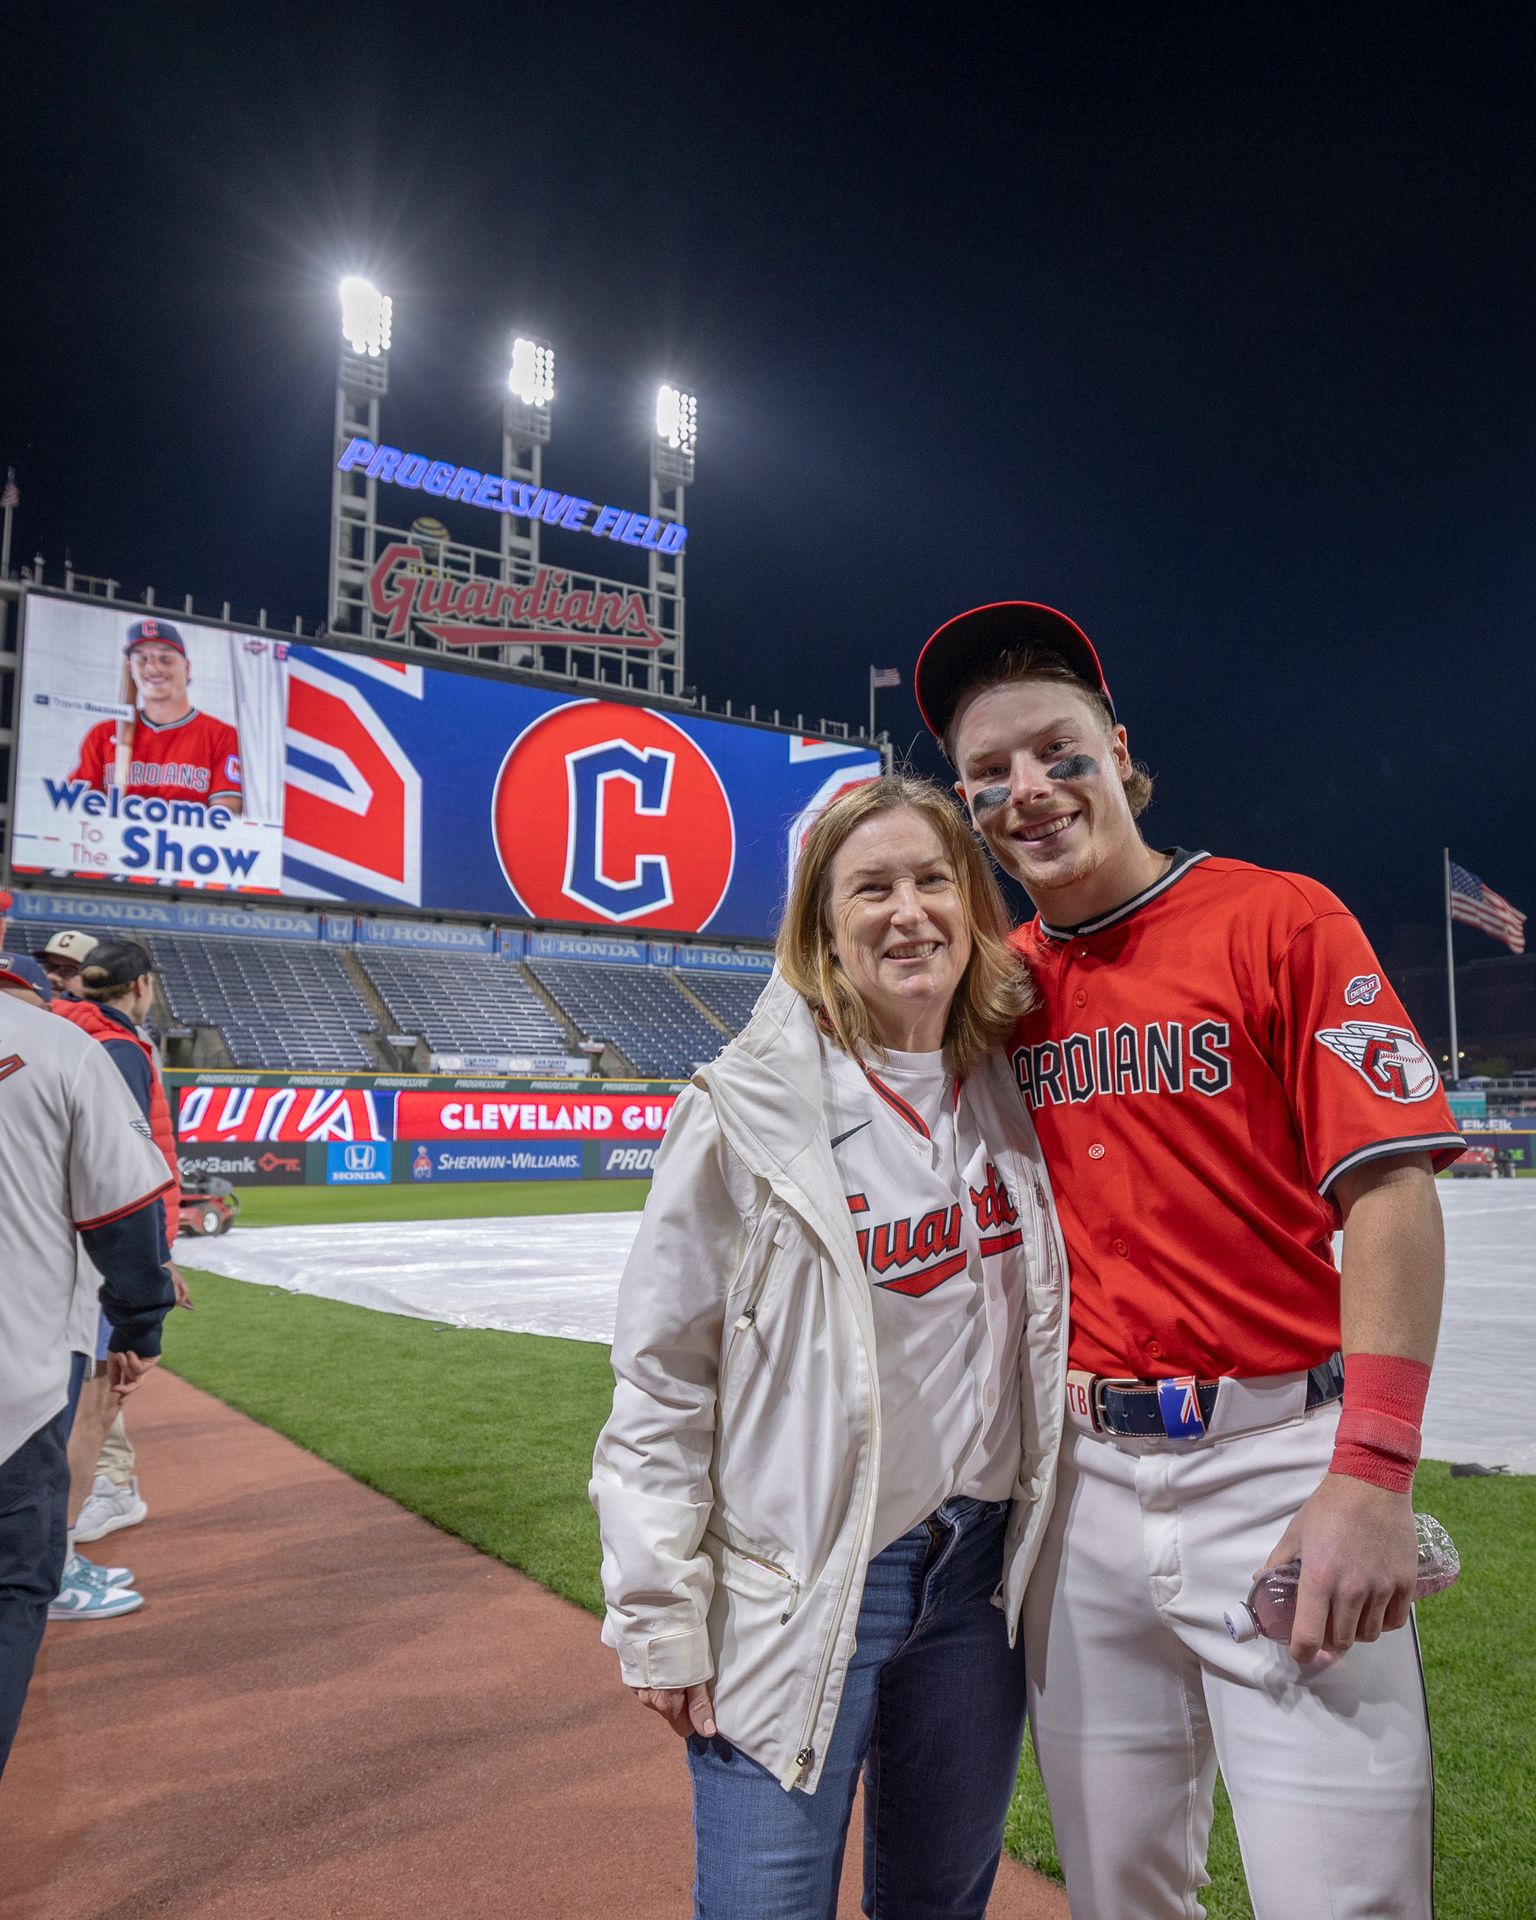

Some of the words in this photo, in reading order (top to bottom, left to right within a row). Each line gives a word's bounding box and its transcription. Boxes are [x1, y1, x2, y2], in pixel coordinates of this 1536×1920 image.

[337, 437, 592, 532] PROGRESSIVE
[592, 505, 689, 555] FIELD
[368, 542, 664, 648] Guardians
[42, 778, 232, 831] Welcome
[79, 822, 103, 843] To
[562, 738, 676, 922] C
[71, 843, 108, 867] The
[119, 826, 261, 878] Show
[52, 900, 170, 924] HONDA
[206, 910, 314, 934] HONDA
[392, 927, 486, 947] HONDA
[554, 940, 641, 959] HONDA
[702, 953, 774, 968] HONDA
[1351, 980, 1376, 999] DEBUT
[195, 1074, 261, 1085] PROGRESSIVE
[287, 1076, 348, 1087] PROGRESSIVE
[373, 1077, 432, 1088] PROGRESSIVE
[454, 1079, 509, 1089] PROGRESSIVE
[530, 1081, 581, 1091] PROGRESSIVE
[440, 1103, 613, 1131] CLEVELAND
[332, 1171, 386, 1181] HONDA
[1067, 1383, 1088, 1416] TB
